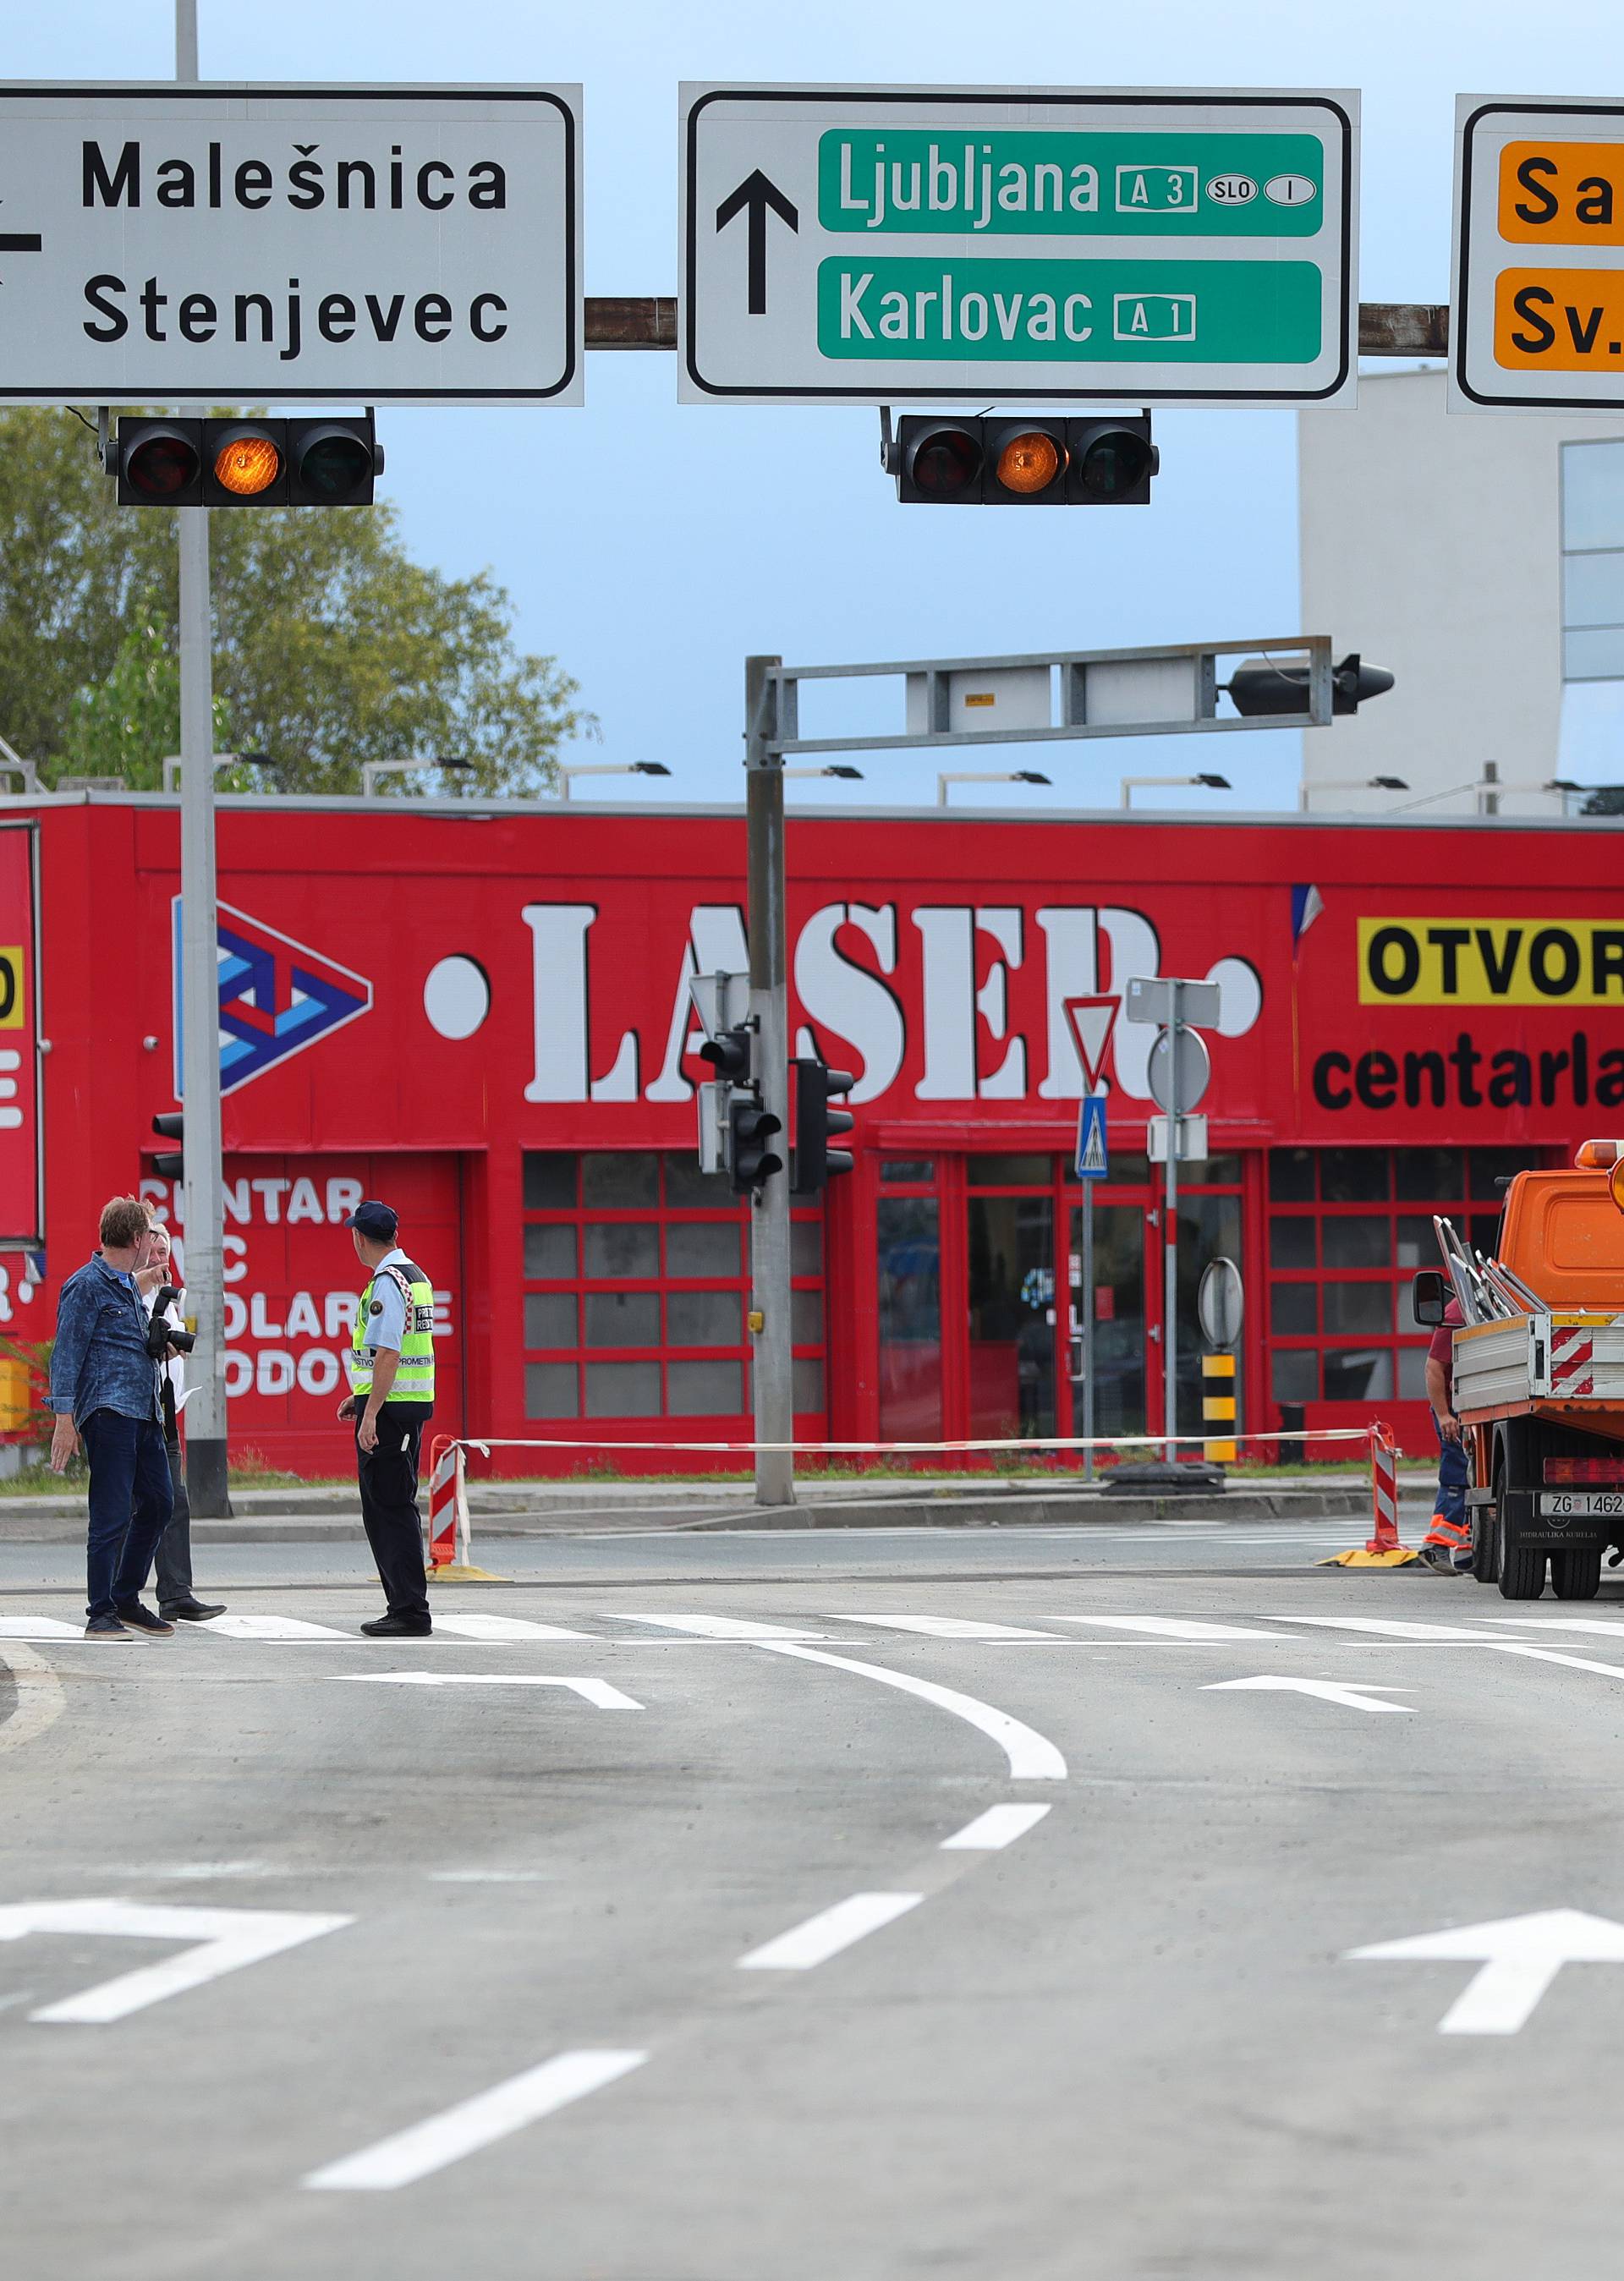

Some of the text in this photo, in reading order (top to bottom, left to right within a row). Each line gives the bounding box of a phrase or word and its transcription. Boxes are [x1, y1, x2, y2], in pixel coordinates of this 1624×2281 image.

[83, 140, 507, 210] Malešnica
[840, 143, 1100, 229] Ljubljana
[1131, 174, 1149, 204] A
[1166, 174, 1183, 205] 3
[1214, 180, 1251, 199] SLO
[1514, 156, 1614, 225] Sa
[83, 273, 509, 361] Stenjevec
[840, 272, 1180, 343] Karlovac A 1
[1511, 286, 1622, 354] Sv.
[521, 902, 1161, 1105] LASER
[1552, 1495, 1572, 1513] ZG
